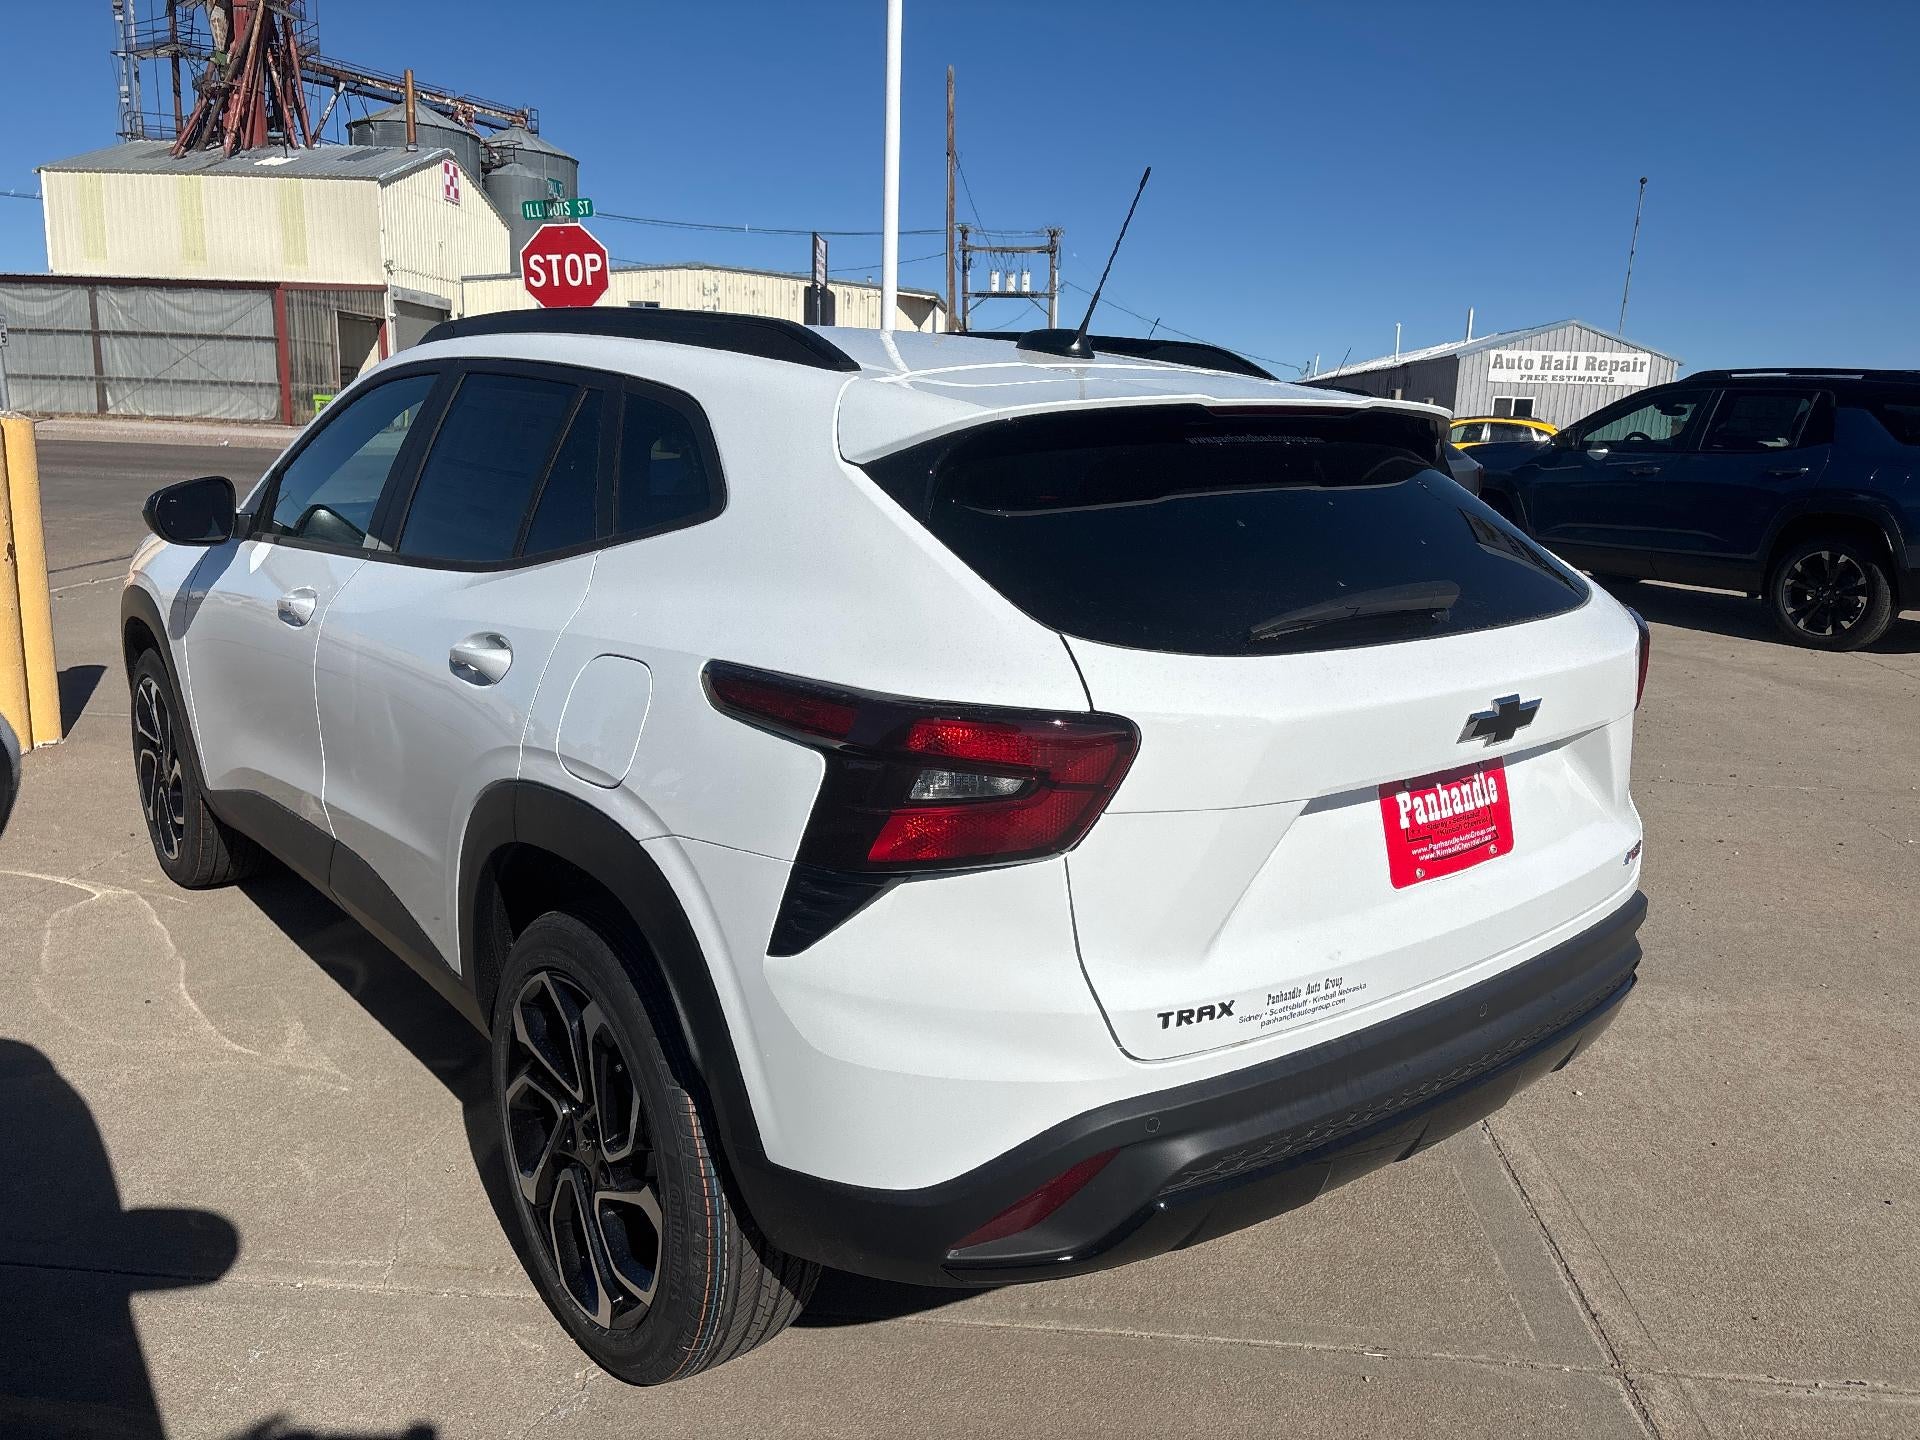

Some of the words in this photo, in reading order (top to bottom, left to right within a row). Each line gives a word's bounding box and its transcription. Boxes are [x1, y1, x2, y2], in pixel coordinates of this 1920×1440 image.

[578, 201, 590, 215] ST
[528, 253, 602, 288] STOP
[1491, 353, 1535, 371] Auto
[1539, 354, 1579, 371] Hail
[1584, 355, 1647, 376] Repair
[1519, 374, 1548, 382] FREE
[1550, 375, 1615, 383] ESTIMATES
[1395, 771, 1499, 830] Panhandle
[1266, 987, 1302, 1007] Panhandle
[1305, 981, 1321, 996] Auto
[1324, 976, 1343, 991] Group
[1157, 1000, 1235, 1030] TRAX
[1238, 1012, 1264, 1024] Sidney
